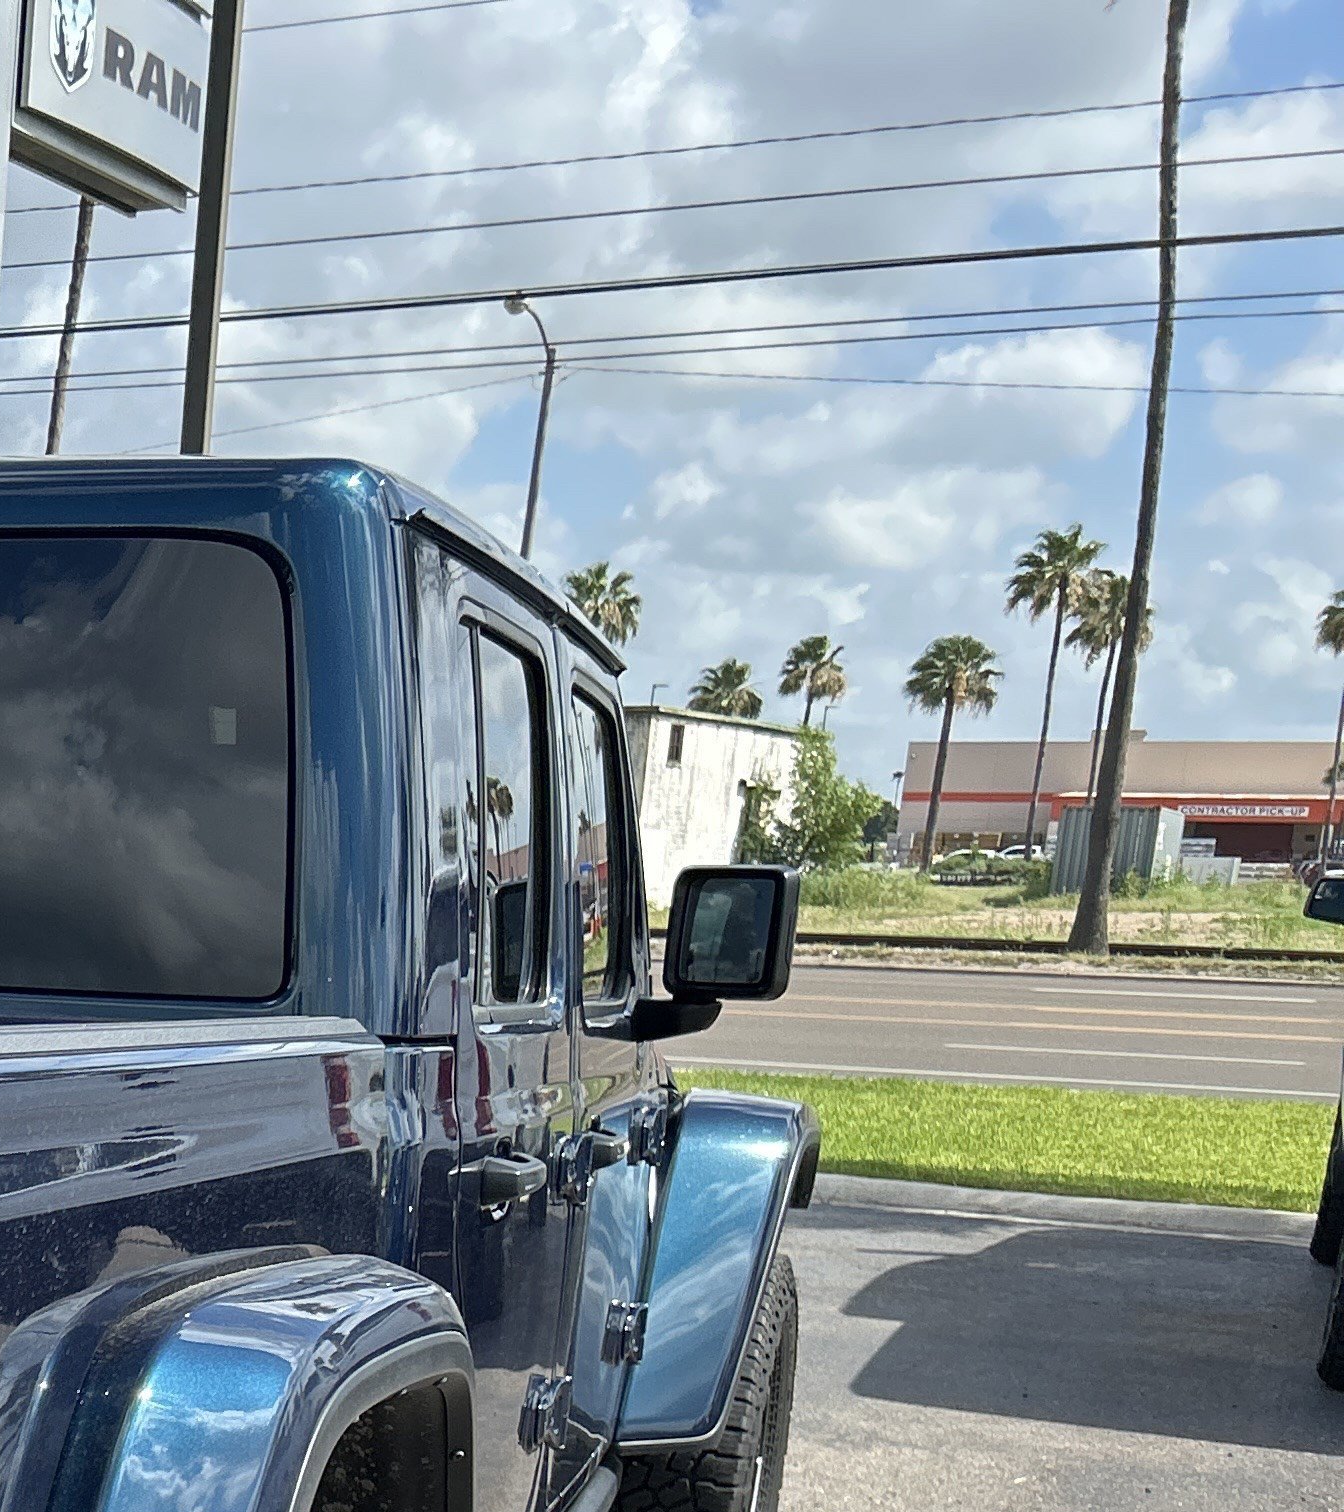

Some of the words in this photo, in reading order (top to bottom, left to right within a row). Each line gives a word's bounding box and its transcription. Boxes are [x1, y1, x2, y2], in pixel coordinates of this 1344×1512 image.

[102, 27, 202, 133] RAM
[1180, 806, 1256, 816] CONTRACTOR
[1258, 807, 1306, 816] PICK-UP
